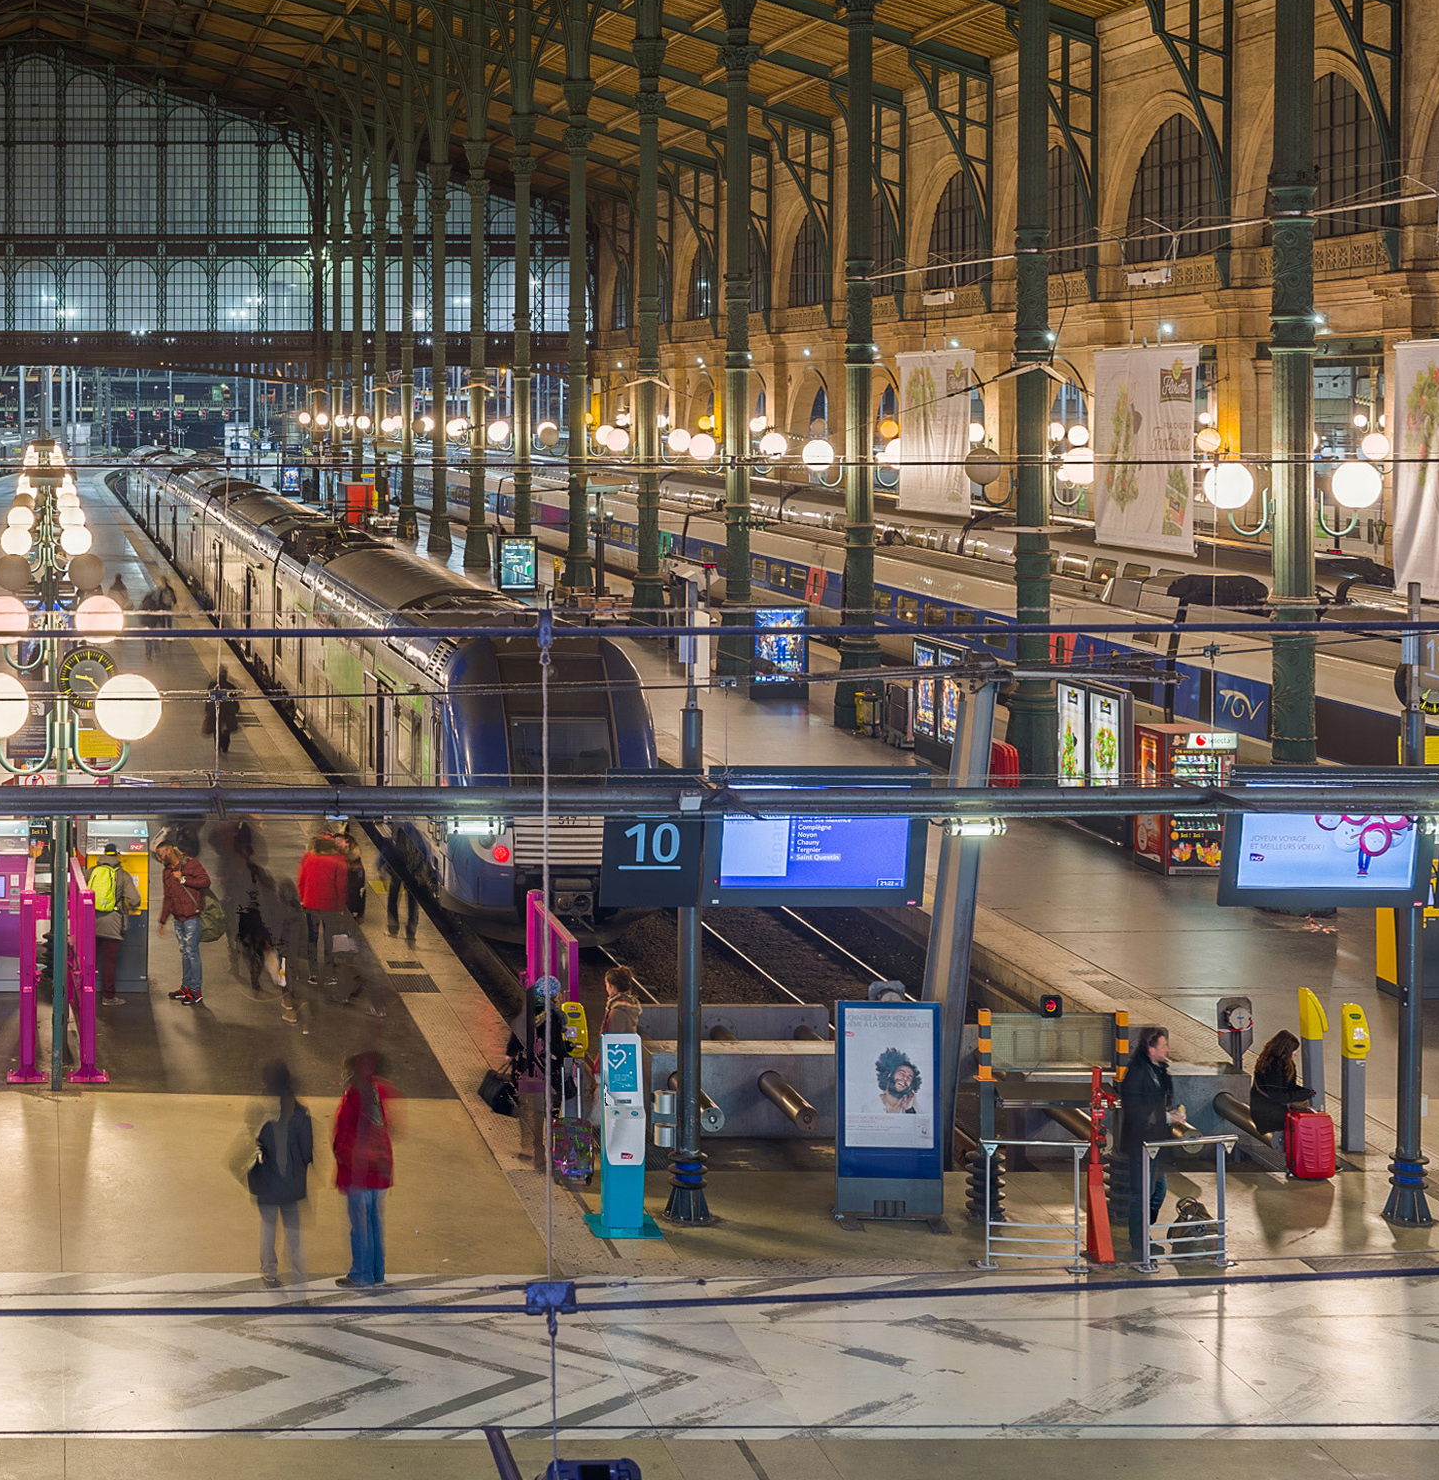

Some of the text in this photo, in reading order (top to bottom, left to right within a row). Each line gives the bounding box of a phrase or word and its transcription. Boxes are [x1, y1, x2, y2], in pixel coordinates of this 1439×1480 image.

[1219, 690, 1264, 720] TGV
[559, 816, 577, 824] 517
[625, 823, 680, 863] 10
